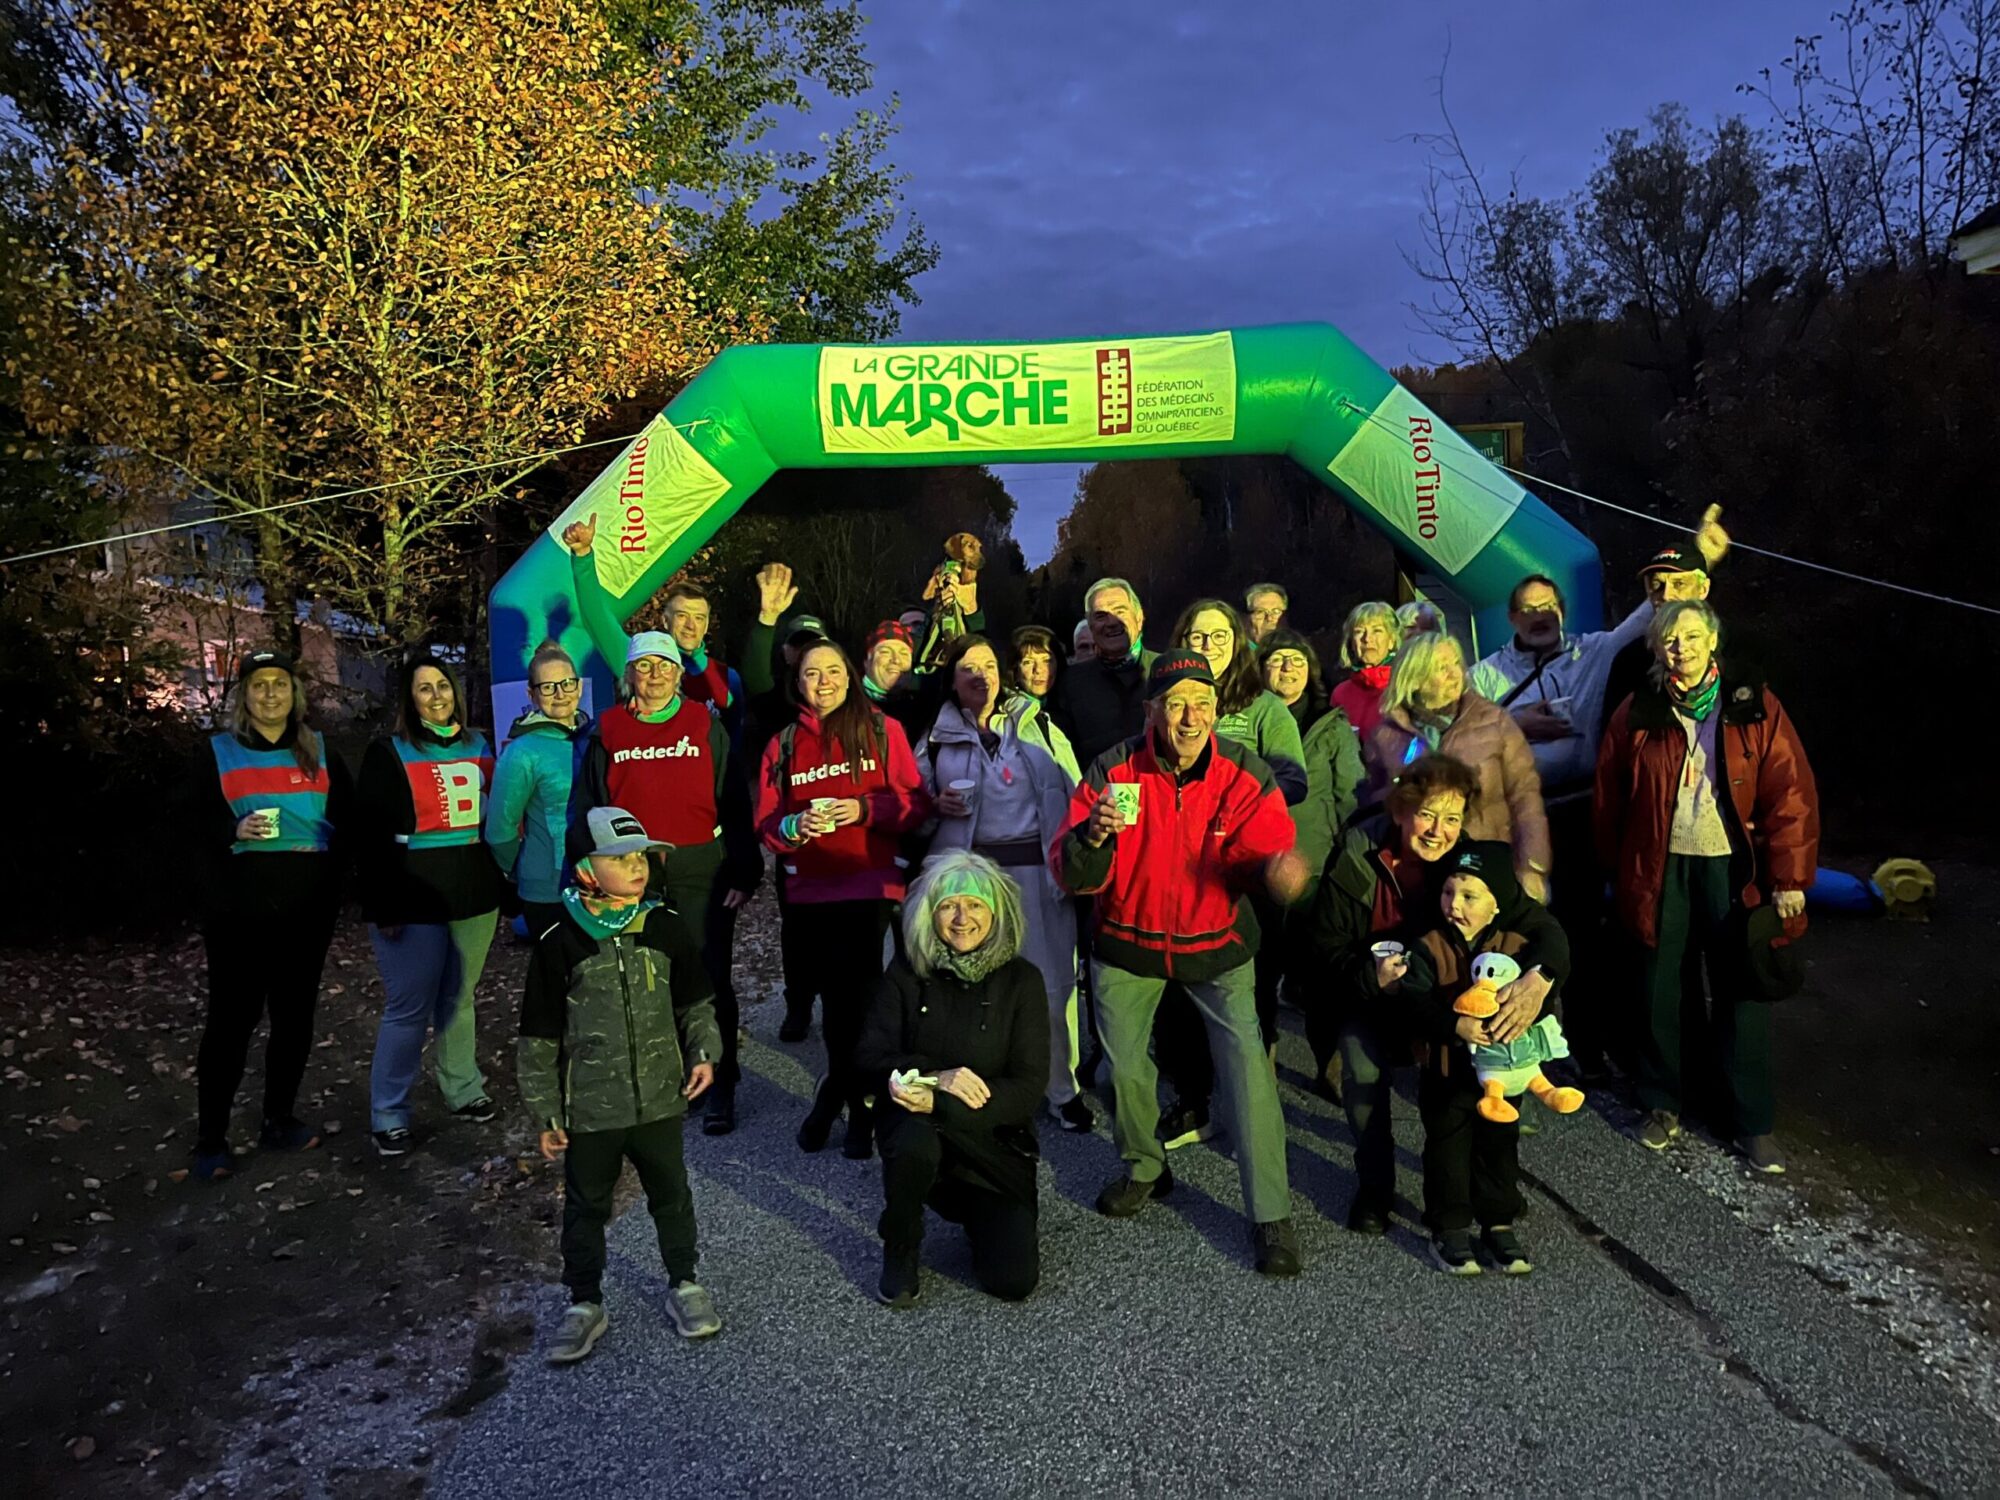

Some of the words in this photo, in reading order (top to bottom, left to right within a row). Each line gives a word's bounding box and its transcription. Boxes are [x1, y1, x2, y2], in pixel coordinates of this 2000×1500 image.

[853, 357, 878, 374] LA
[885, 352, 1040, 381] GRANDE
[1136, 379, 1204, 394] FÉDÉRATION
[1136, 396, 1158, 408] DES
[1160, 392, 1215, 406] MÉDECINS
[830, 379, 1069, 441] MARCHE
[1136, 406, 1224, 422] OMNIPRATICIENS
[1136, 424, 1154, 434] DU
[1156, 421, 1200, 433] QUÉBEC
[613, 735, 700, 764] médecin
[790, 749, 876, 787] médecn
[437, 761, 488, 828] B
